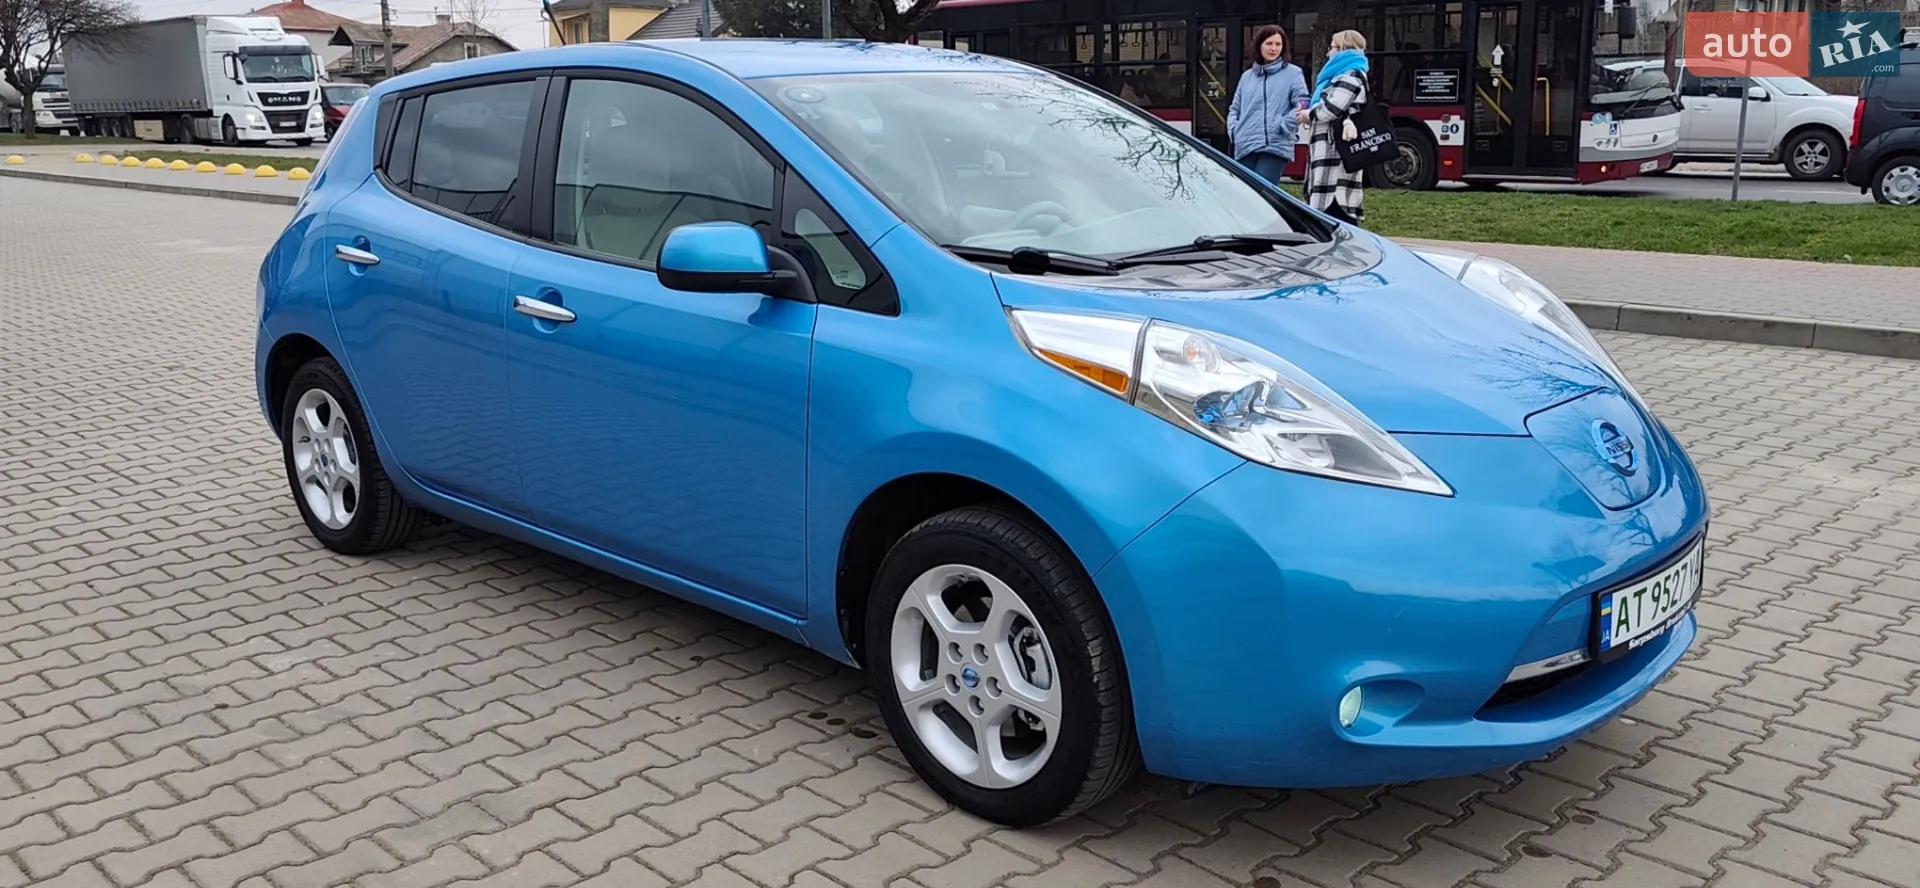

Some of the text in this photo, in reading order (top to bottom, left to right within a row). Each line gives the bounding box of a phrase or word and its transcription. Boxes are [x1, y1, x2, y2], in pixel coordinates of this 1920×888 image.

[1349, 132, 1392, 154] FRANCISCO
[1361, 127, 1376, 139] SAN
[1615, 586, 1648, 638] AT
[1651, 561, 1688, 621] 9527
